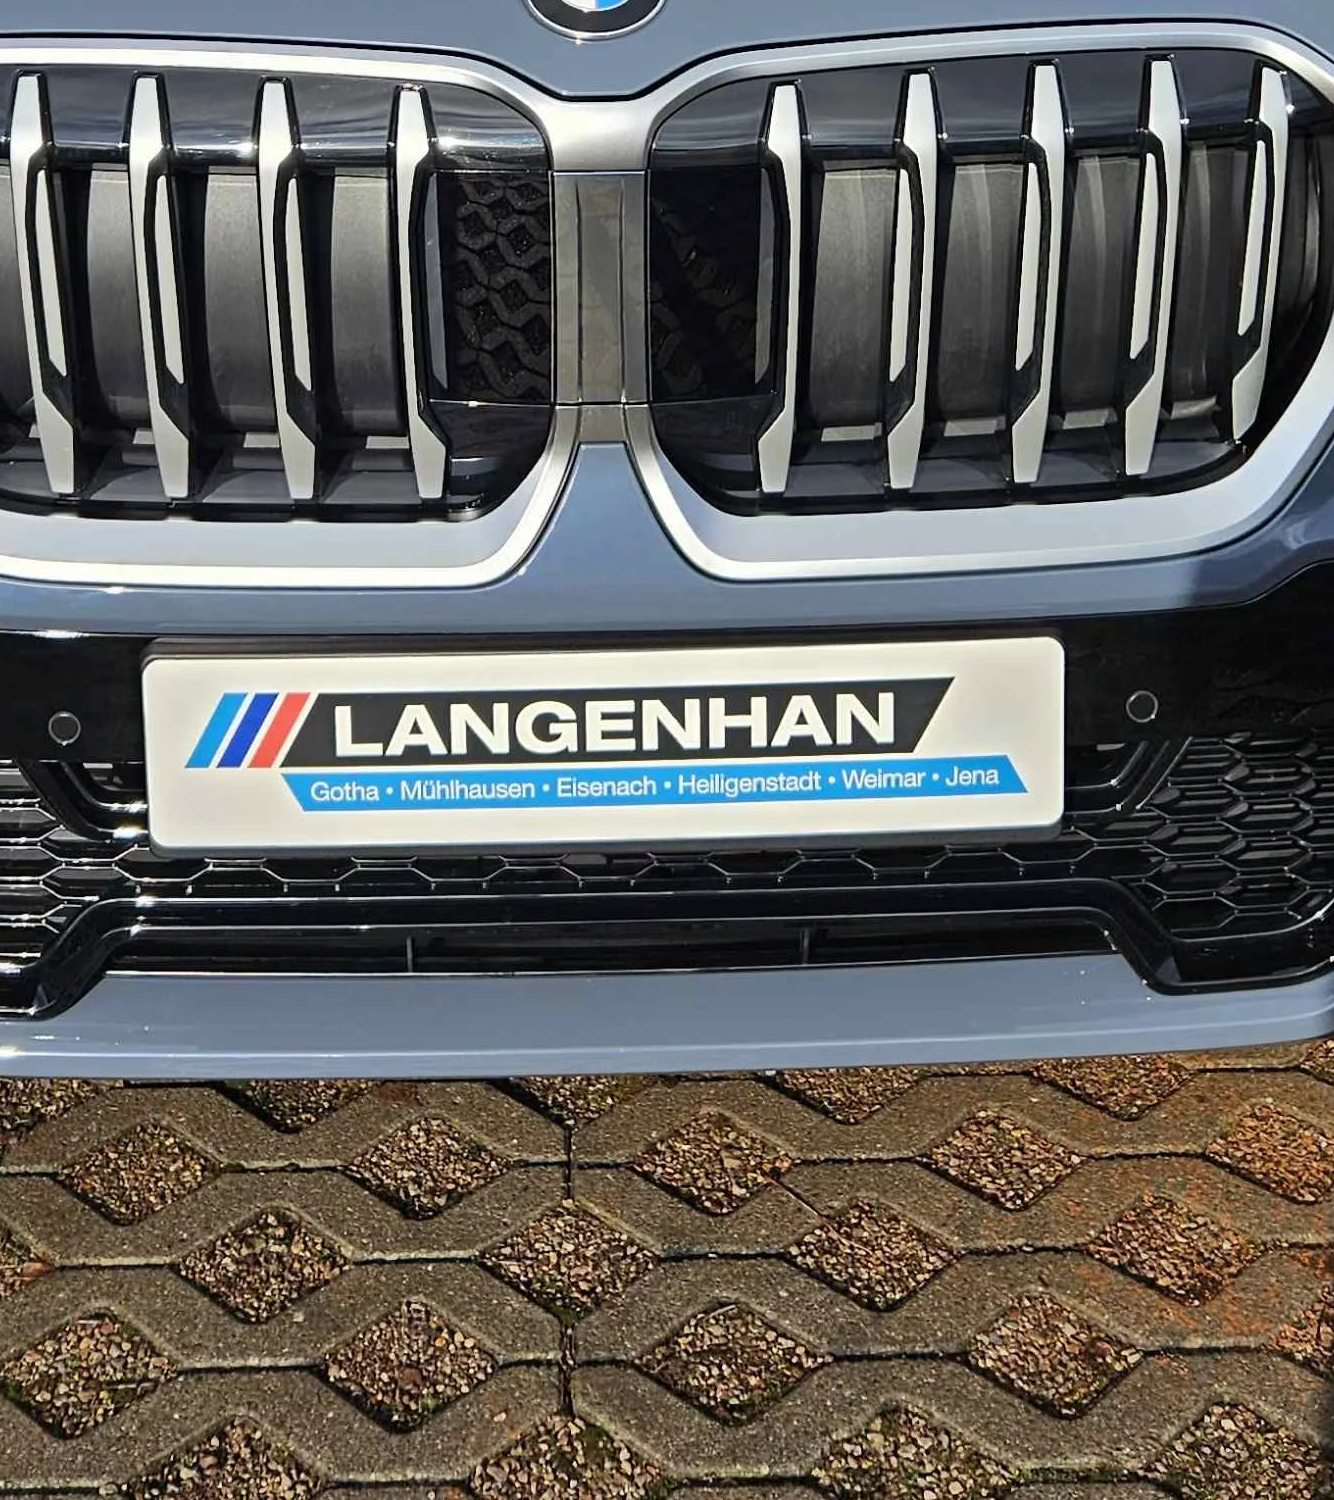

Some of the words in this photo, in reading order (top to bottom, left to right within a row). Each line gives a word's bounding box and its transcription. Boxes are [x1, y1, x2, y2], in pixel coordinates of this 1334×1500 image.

[333, 691, 895, 757] LANGENHAN
[310, 780, 380, 801] Gotha
[400, 778, 536, 800] Mühlhausen
[557, 775, 657, 798] Eisenach
[678, 772, 822, 798] Heiligenstadt
[841, 768, 926, 790] Weimar
[945, 765, 1000, 787] Jena
